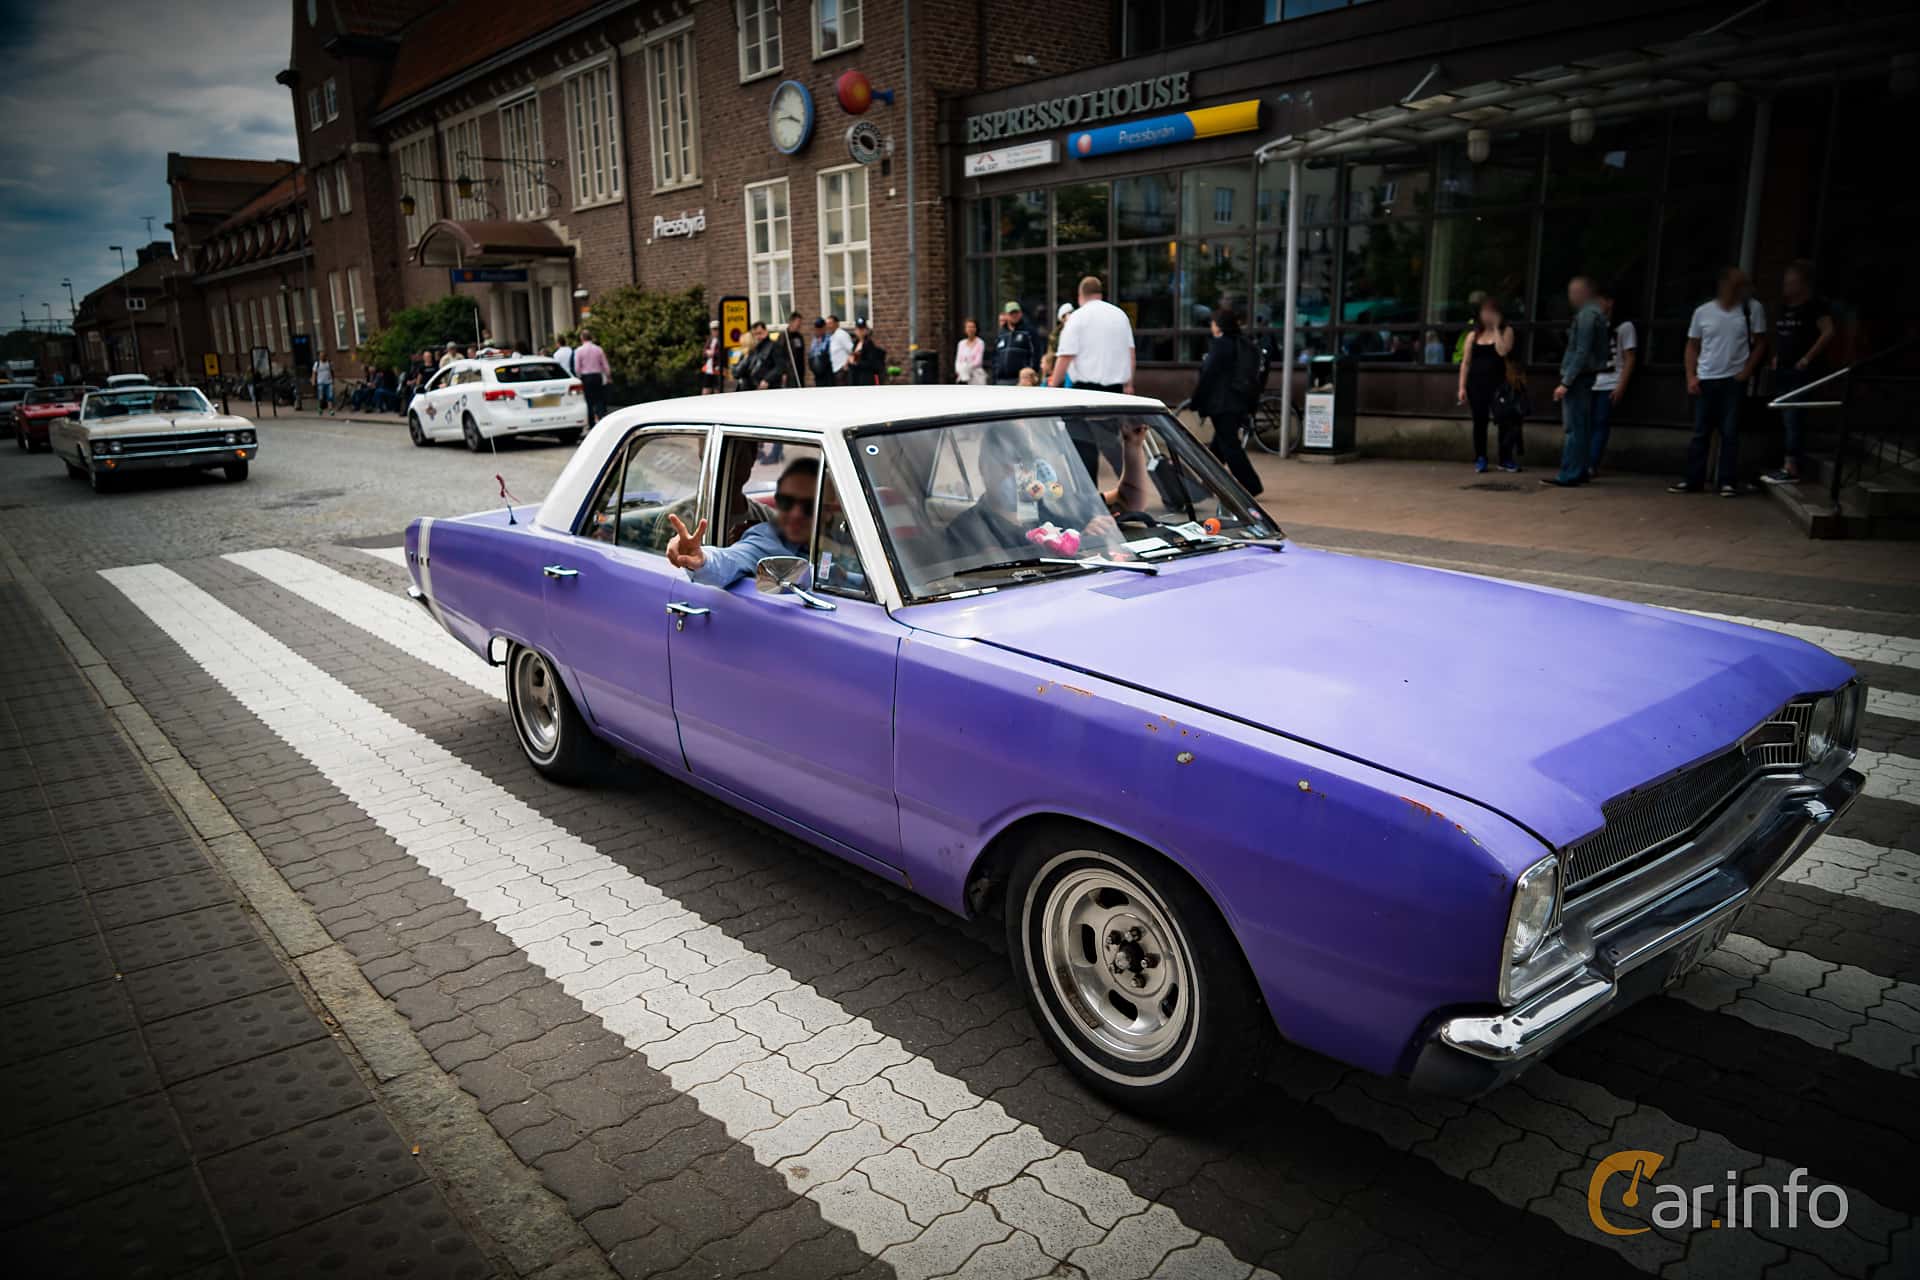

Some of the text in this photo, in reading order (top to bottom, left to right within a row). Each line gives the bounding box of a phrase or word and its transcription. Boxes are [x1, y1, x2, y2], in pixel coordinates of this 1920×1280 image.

[967, 71, 1190, 143] ESPRESSO HOUSE
[1118, 126, 1175, 145] Pressbyrån
